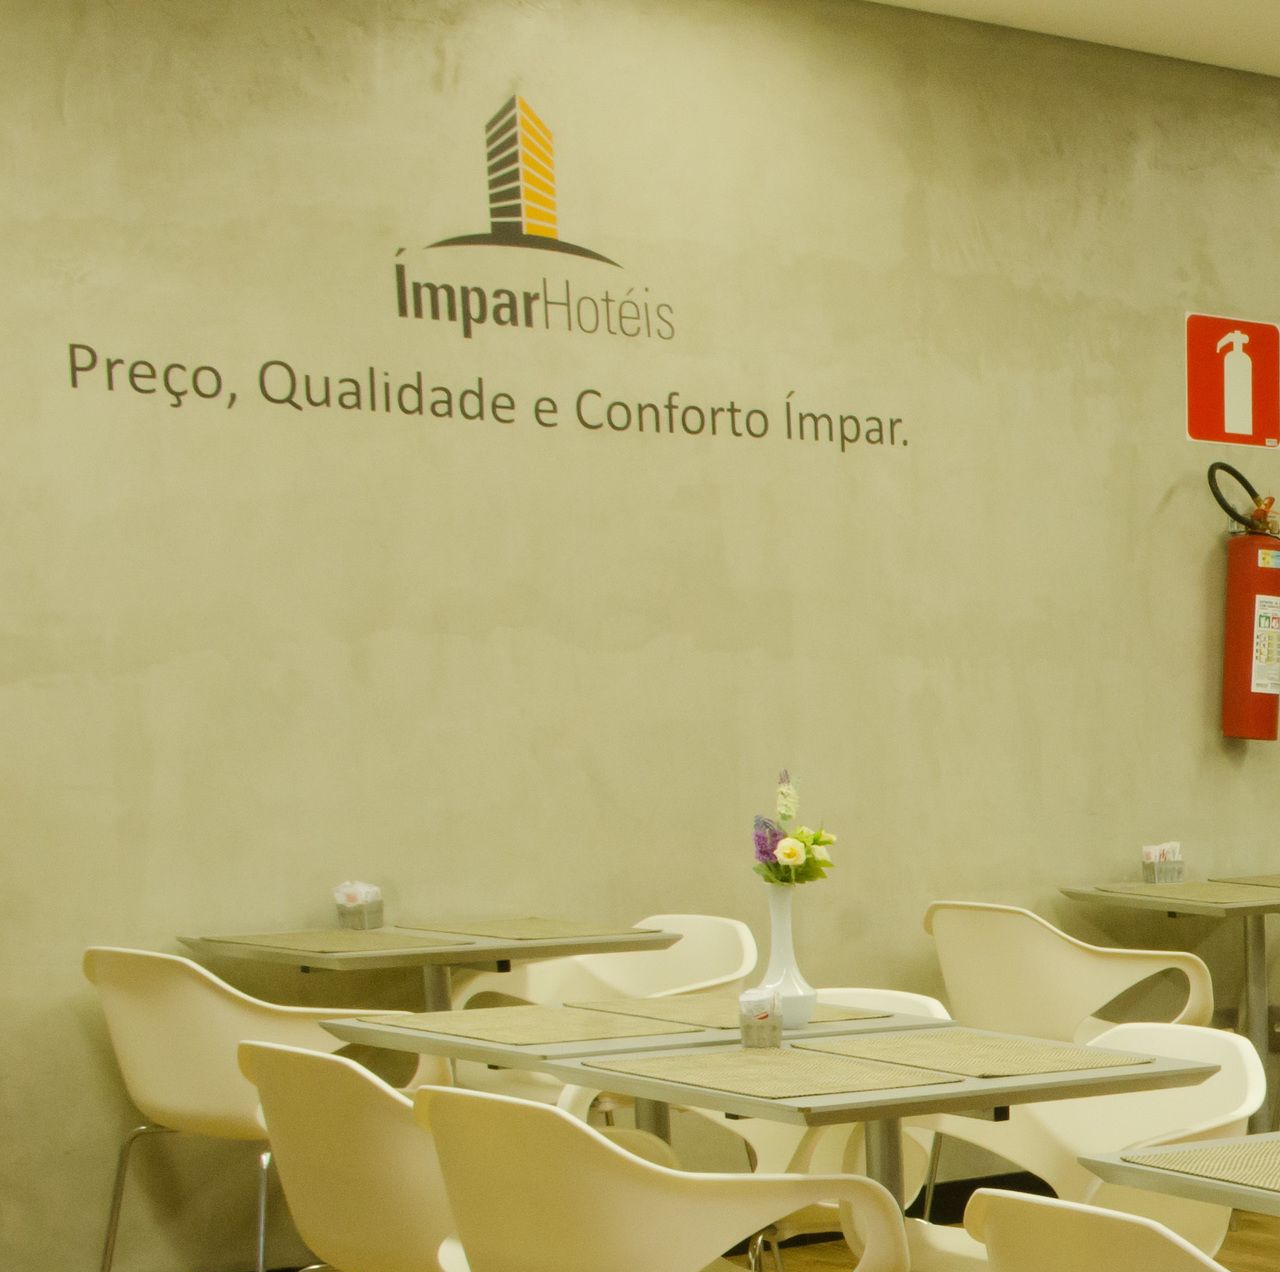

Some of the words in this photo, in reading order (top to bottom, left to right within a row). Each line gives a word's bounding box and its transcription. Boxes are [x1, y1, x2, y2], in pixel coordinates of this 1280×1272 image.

[68, 342, 238, 410] Preço,
[258, 358, 516, 424] Qualidade
[533, 395, 559, 428] e
[575, 388, 770, 438] Conforto
[784, 389, 909, 453] Ímpar.
